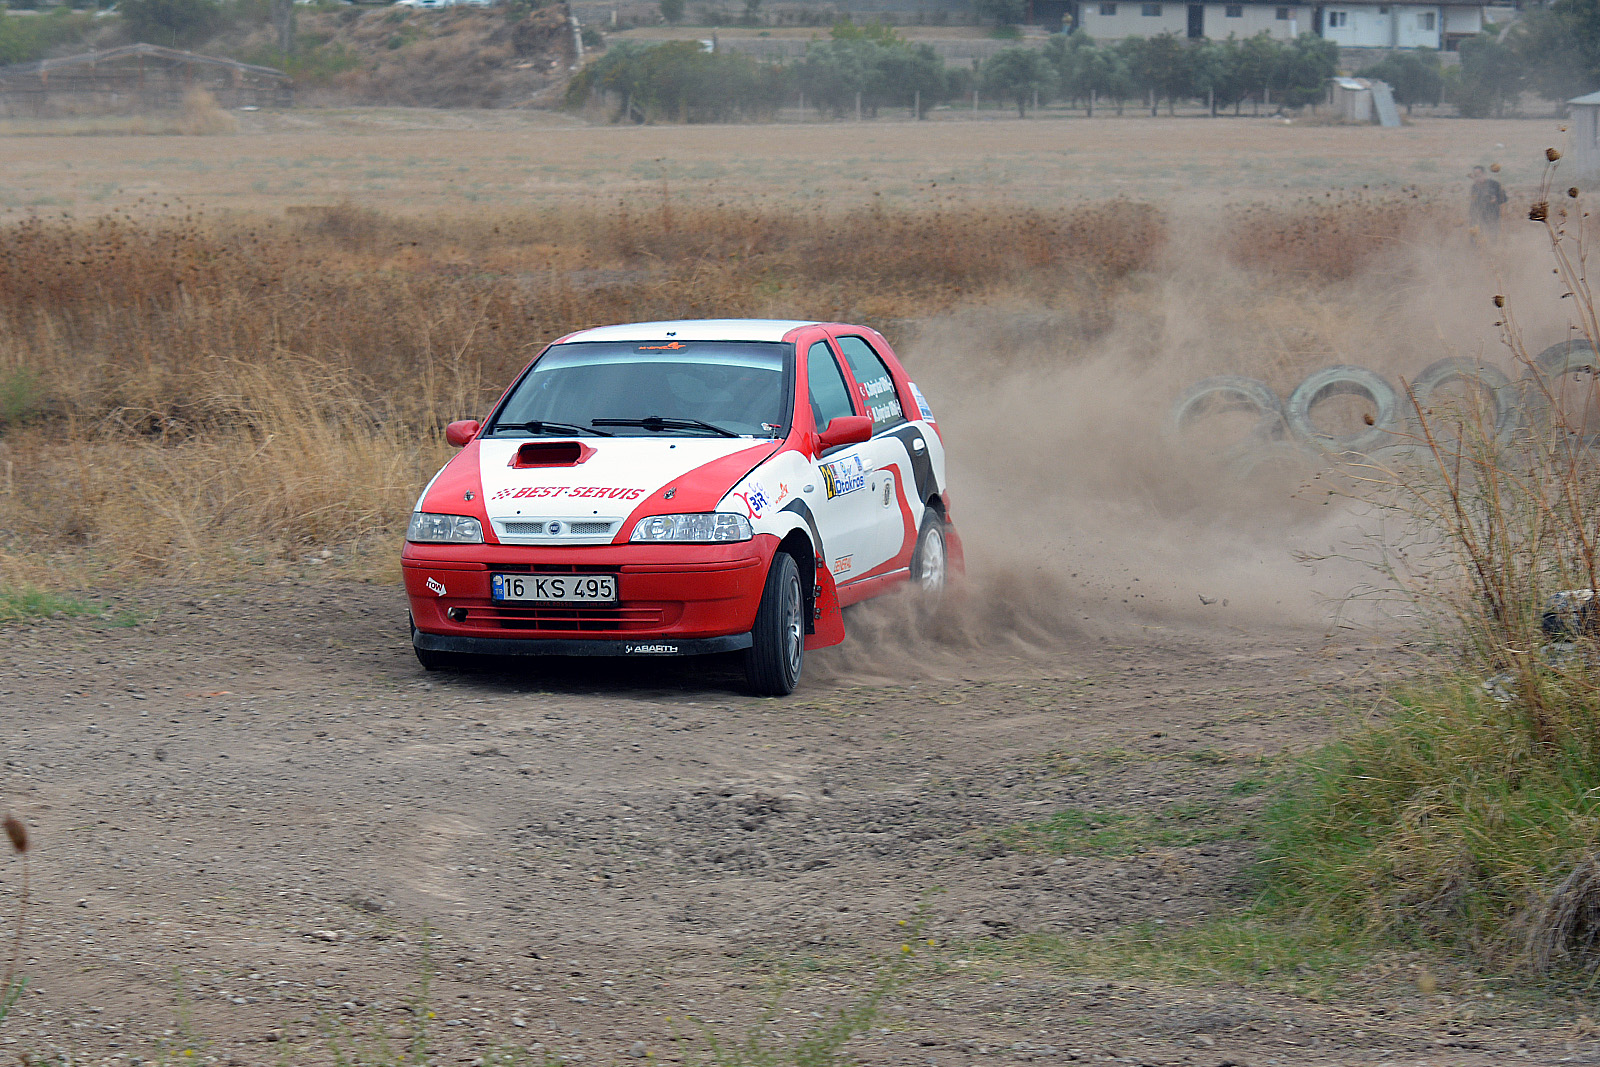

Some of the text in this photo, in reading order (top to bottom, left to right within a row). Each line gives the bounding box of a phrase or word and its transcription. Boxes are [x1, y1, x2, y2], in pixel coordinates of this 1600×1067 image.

[835, 476, 864, 494] Otokros
[512, 487, 645, 500] BEST SERVIS
[504, 578, 612, 598] 16 KS 495
[634, 645, 678, 653] ABARTH
